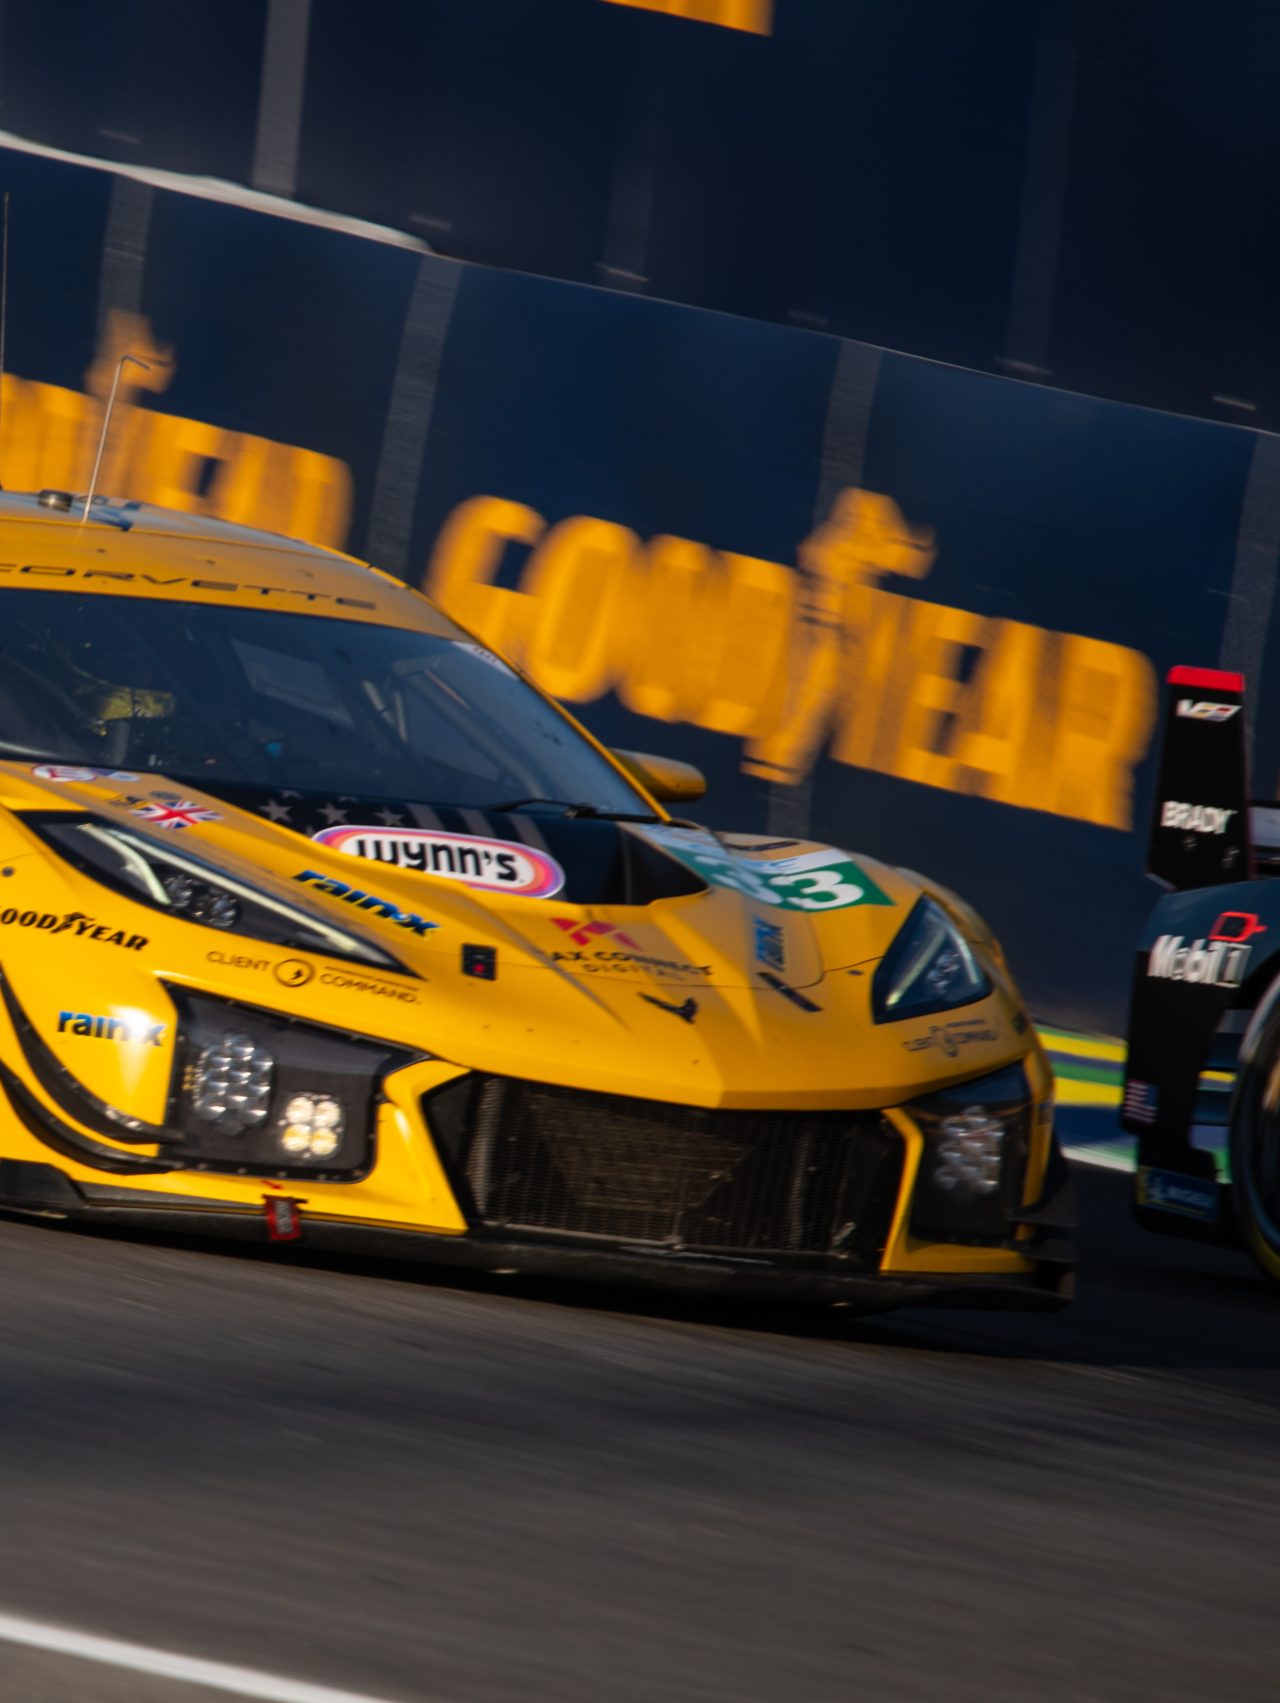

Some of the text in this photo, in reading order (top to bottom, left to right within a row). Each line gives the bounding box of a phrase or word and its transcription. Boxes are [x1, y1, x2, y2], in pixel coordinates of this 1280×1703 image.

[1160, 801, 1238, 835] BRADY
[206, 950, 418, 1004] CLIENT COMMAND
